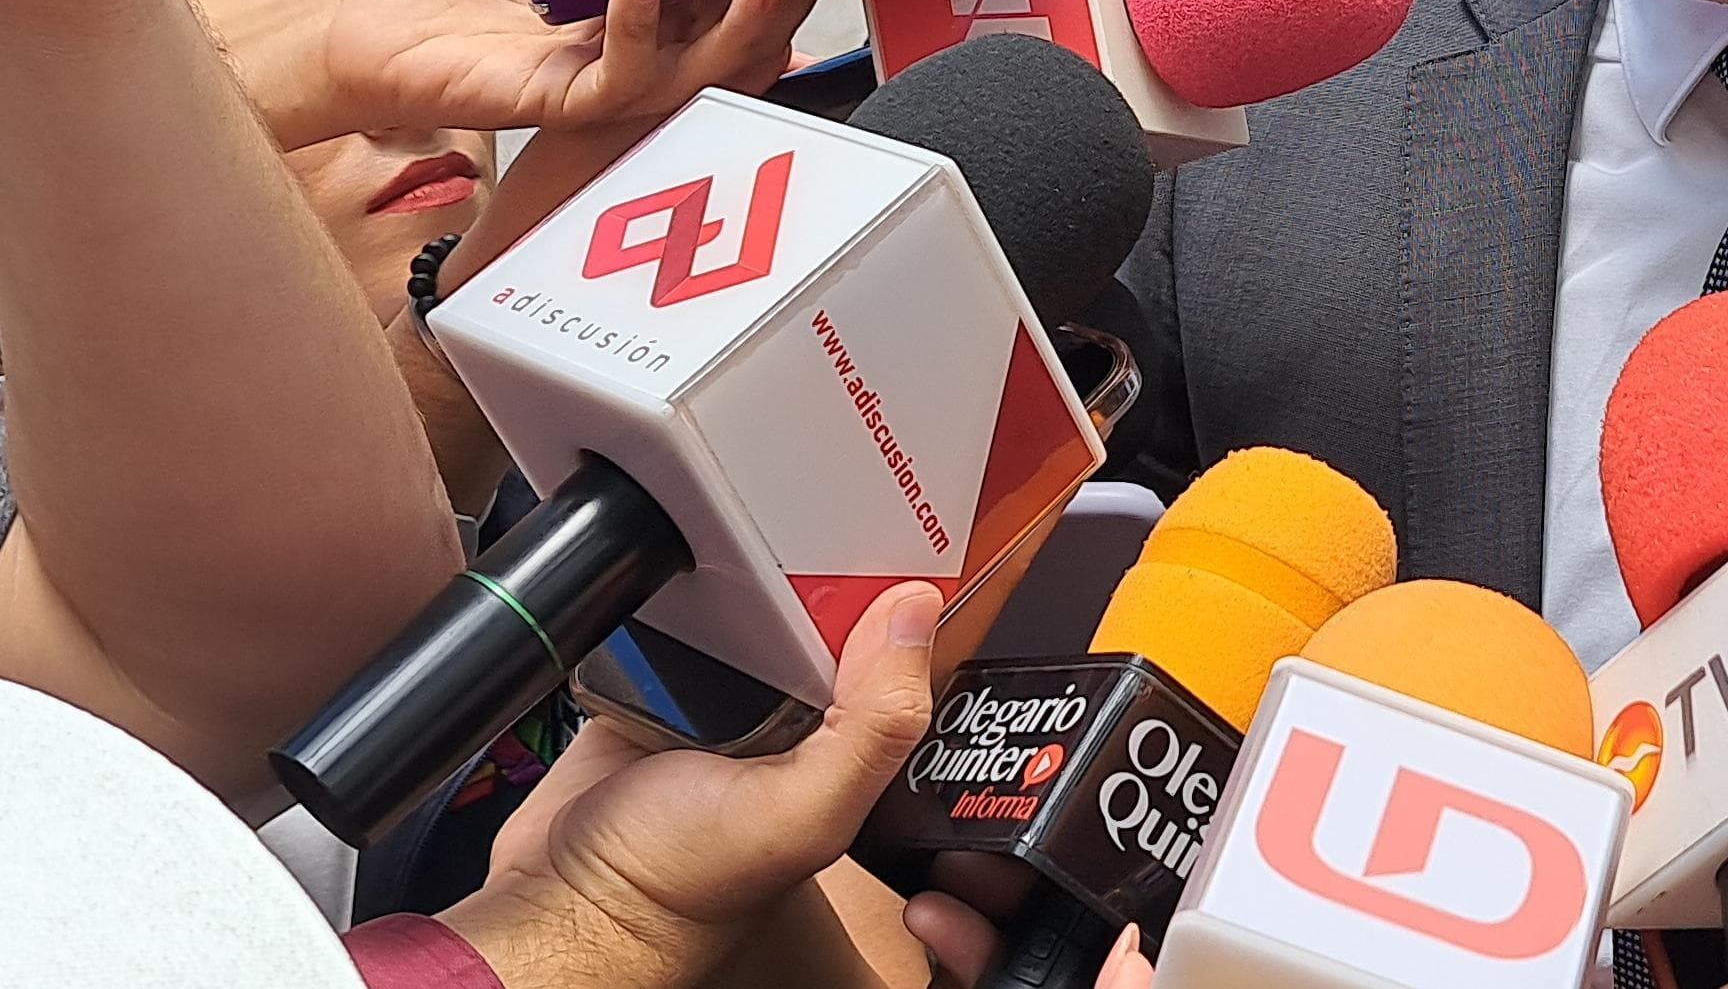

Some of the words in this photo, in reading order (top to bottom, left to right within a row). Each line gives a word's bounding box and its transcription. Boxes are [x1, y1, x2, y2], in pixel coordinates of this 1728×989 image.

[492, 287, 671, 373] adiscusión
[811, 309, 951, 555] www.adiscusion.com
[935, 683, 1087, 746] Olegario
[950, 785, 1031, 820] Informa
